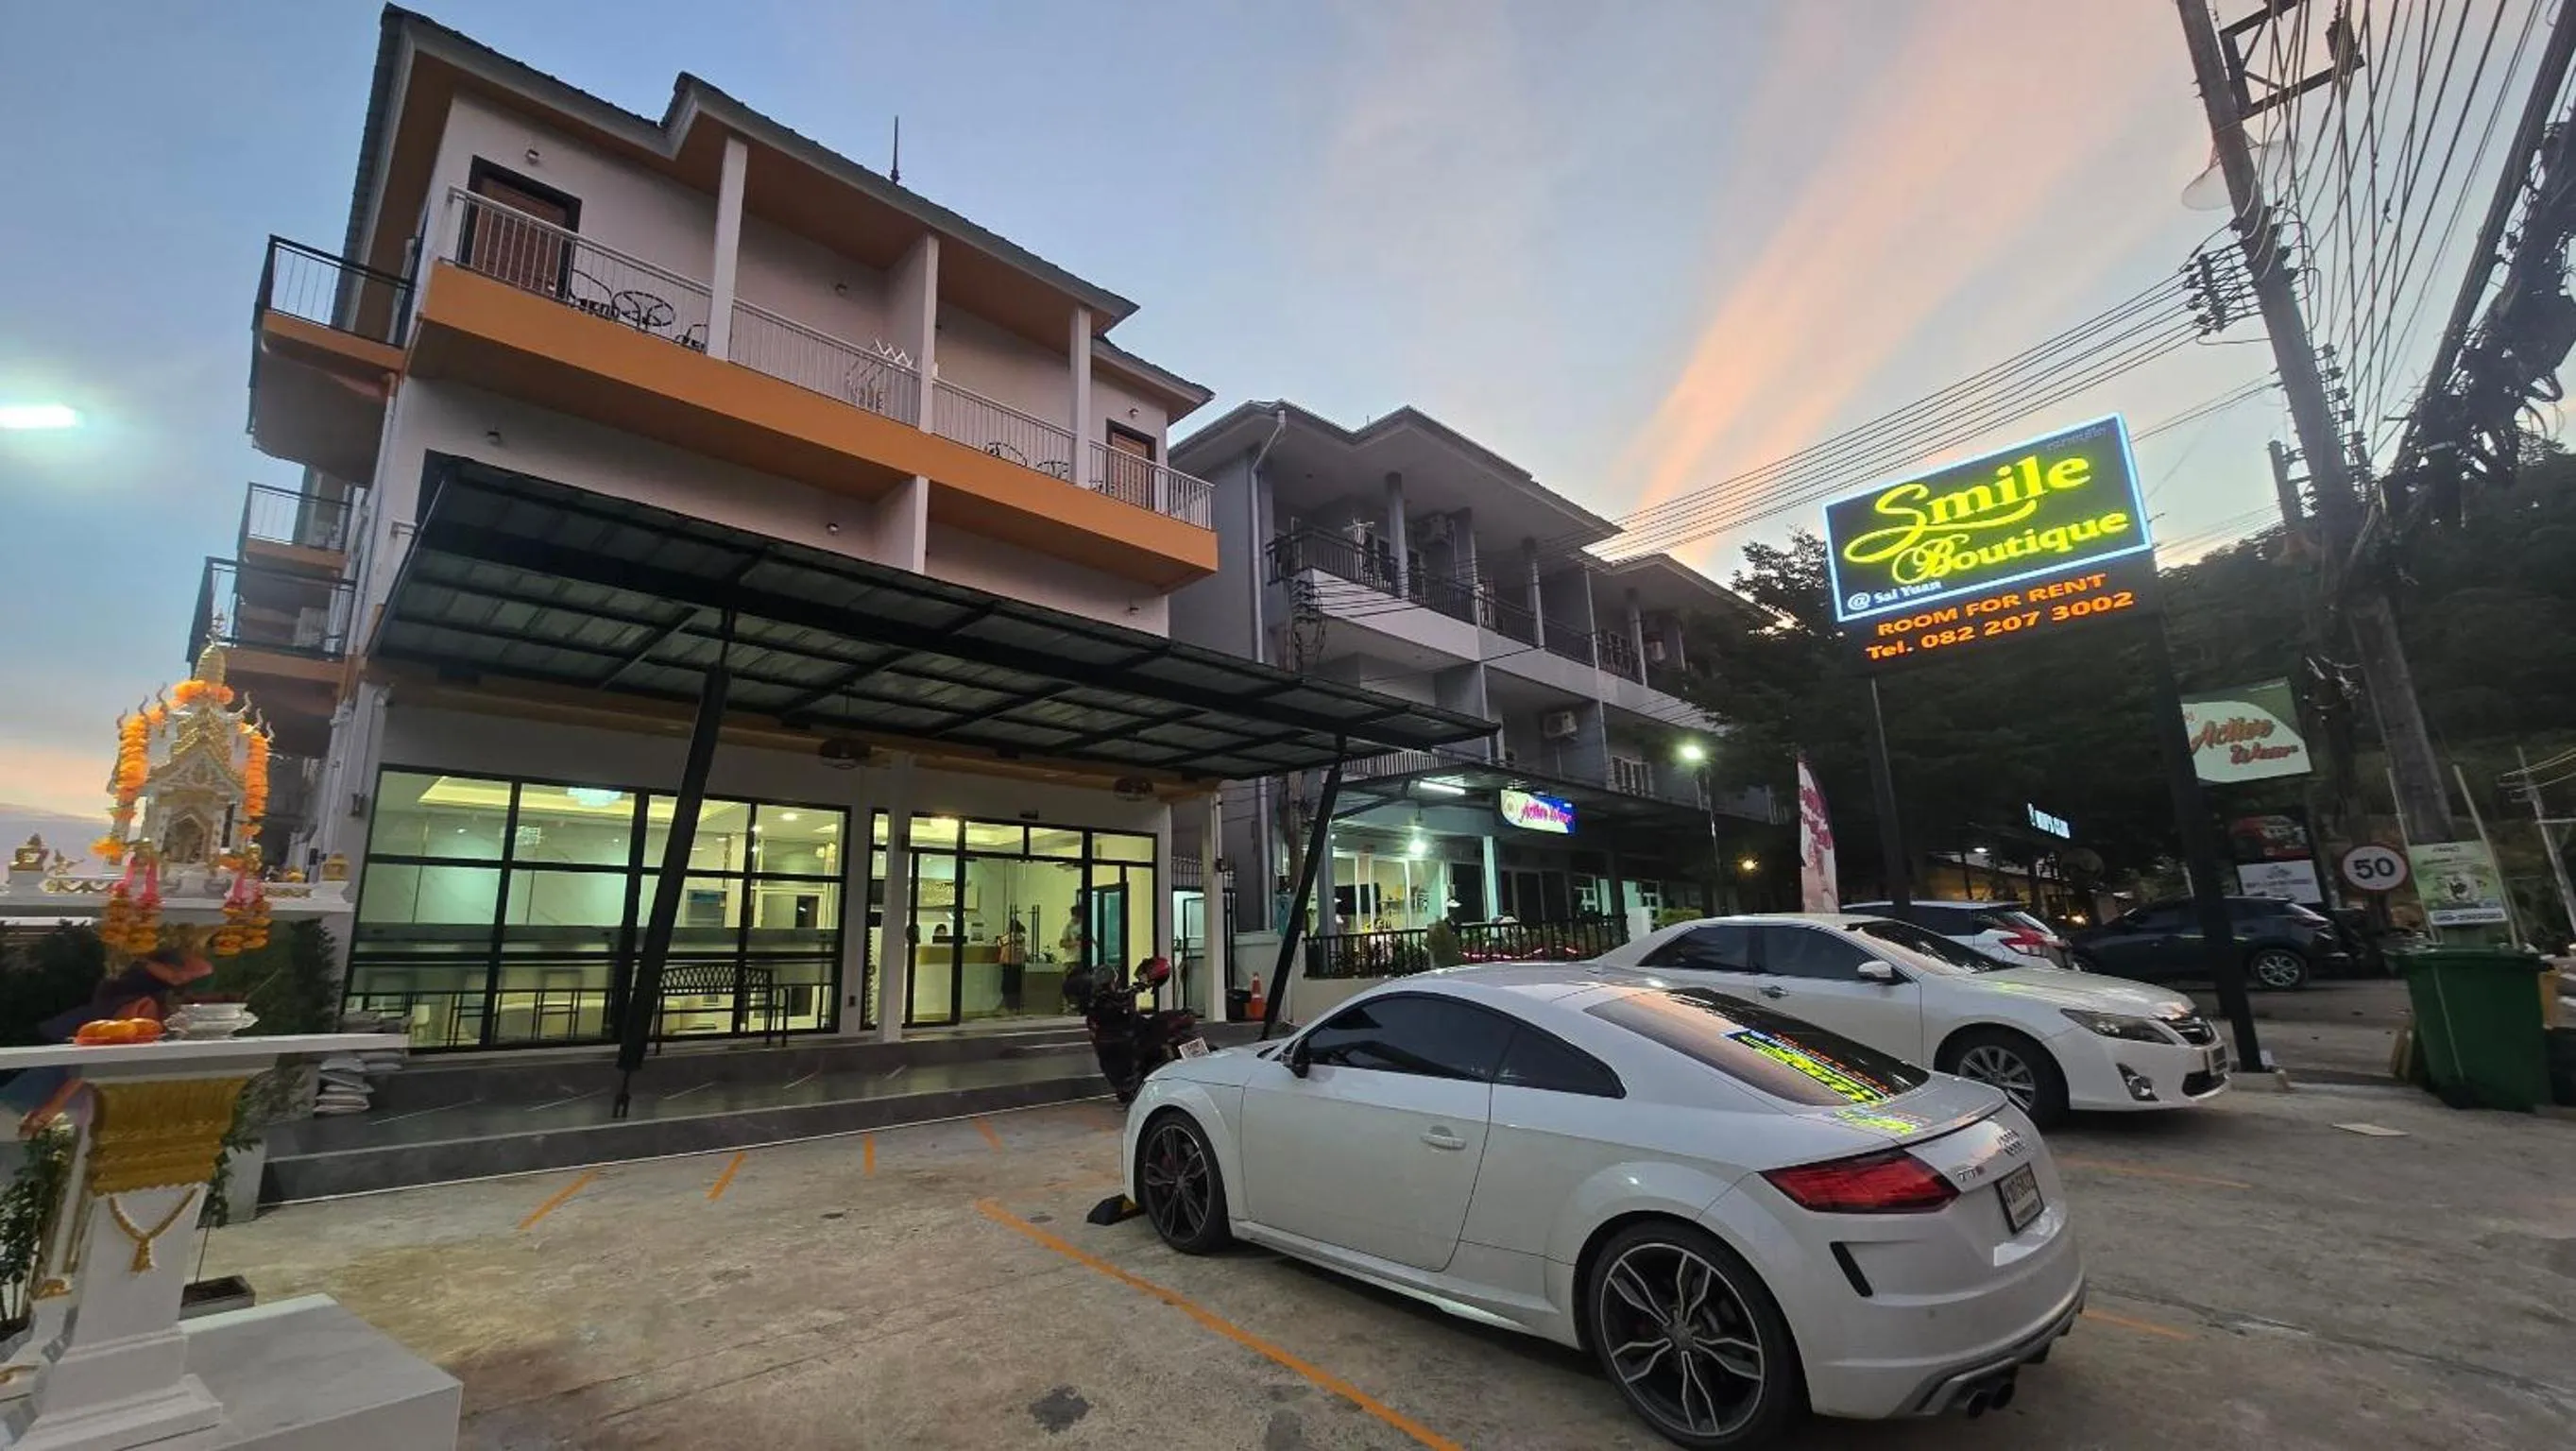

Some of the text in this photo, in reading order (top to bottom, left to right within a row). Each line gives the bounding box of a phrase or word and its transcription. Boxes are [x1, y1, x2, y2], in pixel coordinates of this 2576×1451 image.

[1844, 454, 2091, 563] Smile
[1892, 510, 2129, 585] Boutique
[1848, 592, 1870, 610] @
[1901, 581, 1942, 597] Yuan
[1866, 591, 2135, 659] Tel. 082 207 3002
[1877, 572, 2107, 637] ROOM FOR RENT
[2353, 856, 2396, 879] 50
